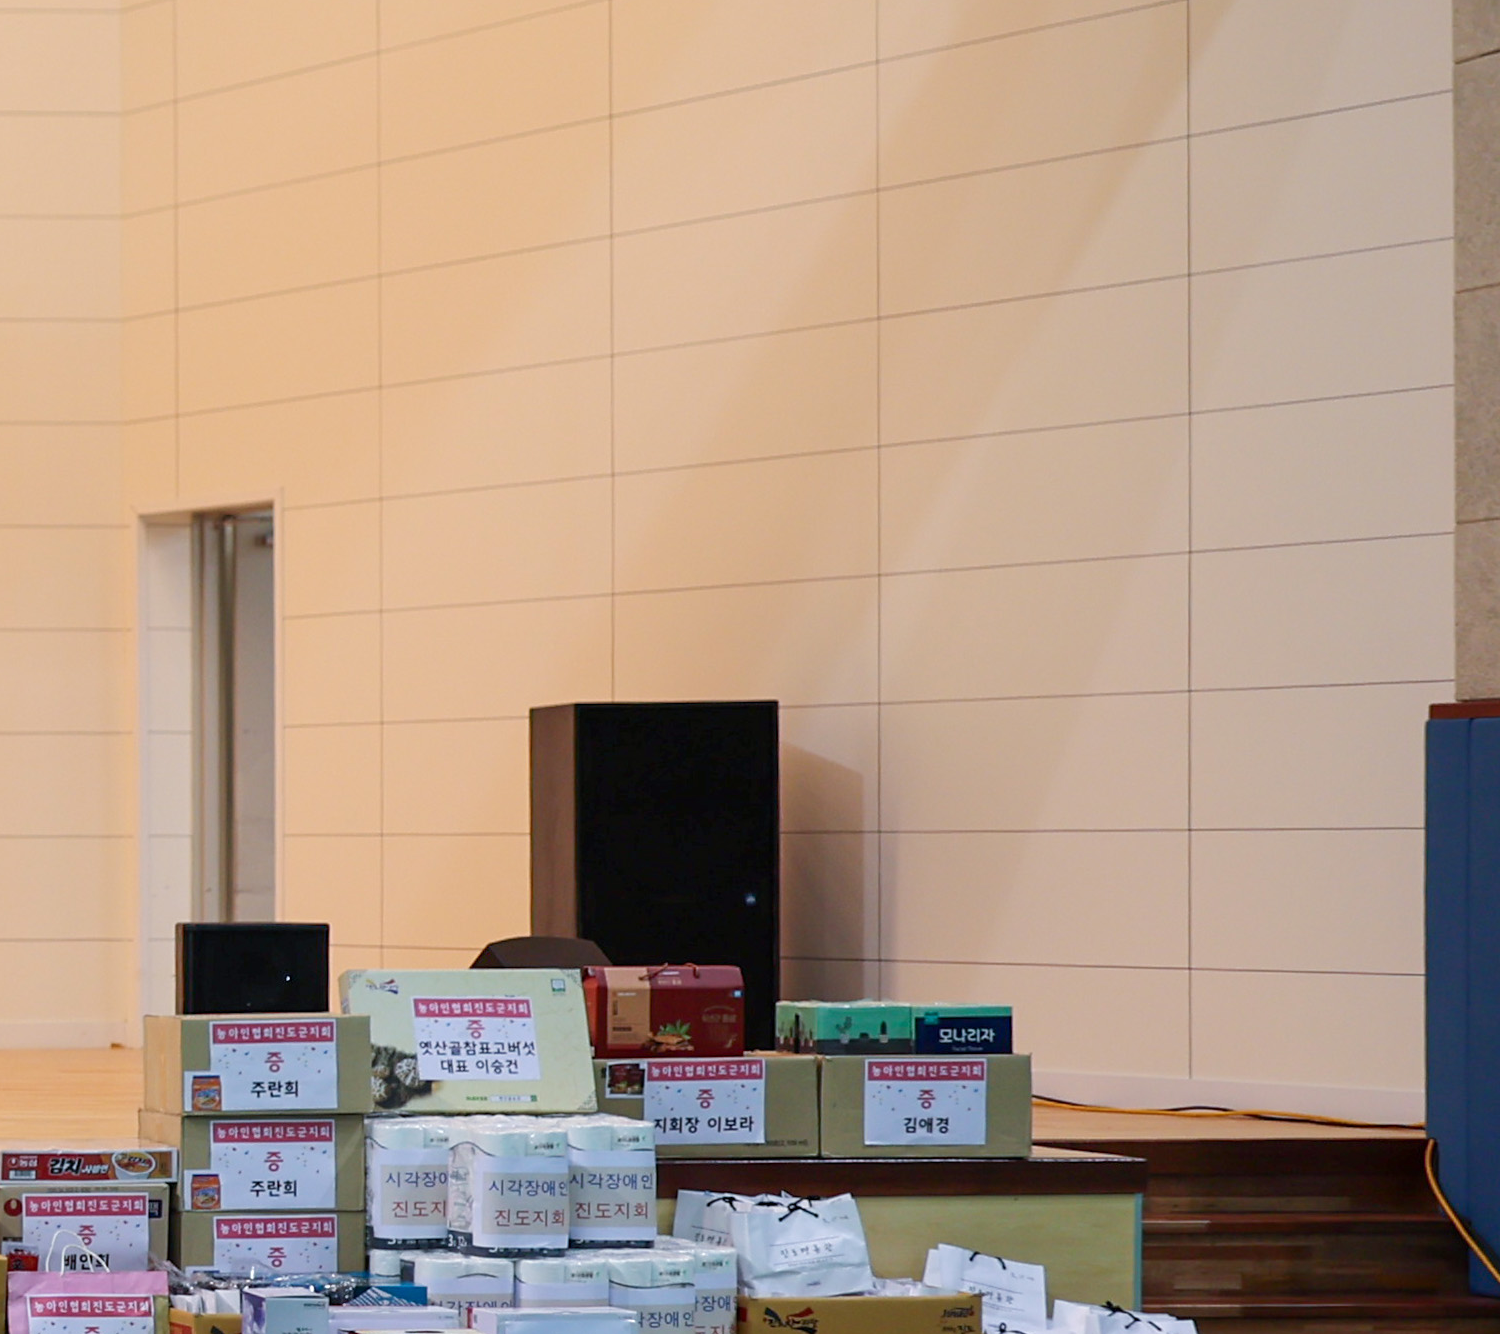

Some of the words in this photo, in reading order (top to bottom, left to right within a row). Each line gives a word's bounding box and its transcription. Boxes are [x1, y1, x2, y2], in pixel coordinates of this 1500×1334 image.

[216, 1026, 333, 1040] 농아인협회진도군지회
[466, 1019, 486, 1040] 증
[938, 1028, 996, 1044] 모나리자
[264, 1051, 285, 1073] 증
[440, 1058, 470, 1075] 대표
[475, 1058, 519, 1075] 이승건
[651, 1063, 762, 1078] 농아인협회진도군지회
[872, 1064, 983, 1078] 농아인협회진도군지회
[695, 1088, 715, 1110] 증
[916, 1089, 937, 1110] 증
[217, 1125, 331, 1139] 농아인협회진도군지회
[654, 1116, 700, 1134] 지회장
[707, 1116, 754, 1134] 이보라
[903, 1117, 950, 1134] 김애경
[50, 1157, 84, 1175] 김치
[263, 1151, 284, 1172] 증
[569, 1172, 654, 1191] 시각장애인
[29, 1199, 145, 1214] 농아인협회진도군지회
[391, 1200, 449, 1218] 진도지
[574, 1201, 649, 1220] 진도지회
[494, 1209, 565, 1229] 진도지회
[77, 1224, 97, 1247] 증
[220, 1222, 333, 1235] 농아인협회진도군지회
[266, 1246, 288, 1268] 증
[638, 1310, 696, 1329] 장애인
